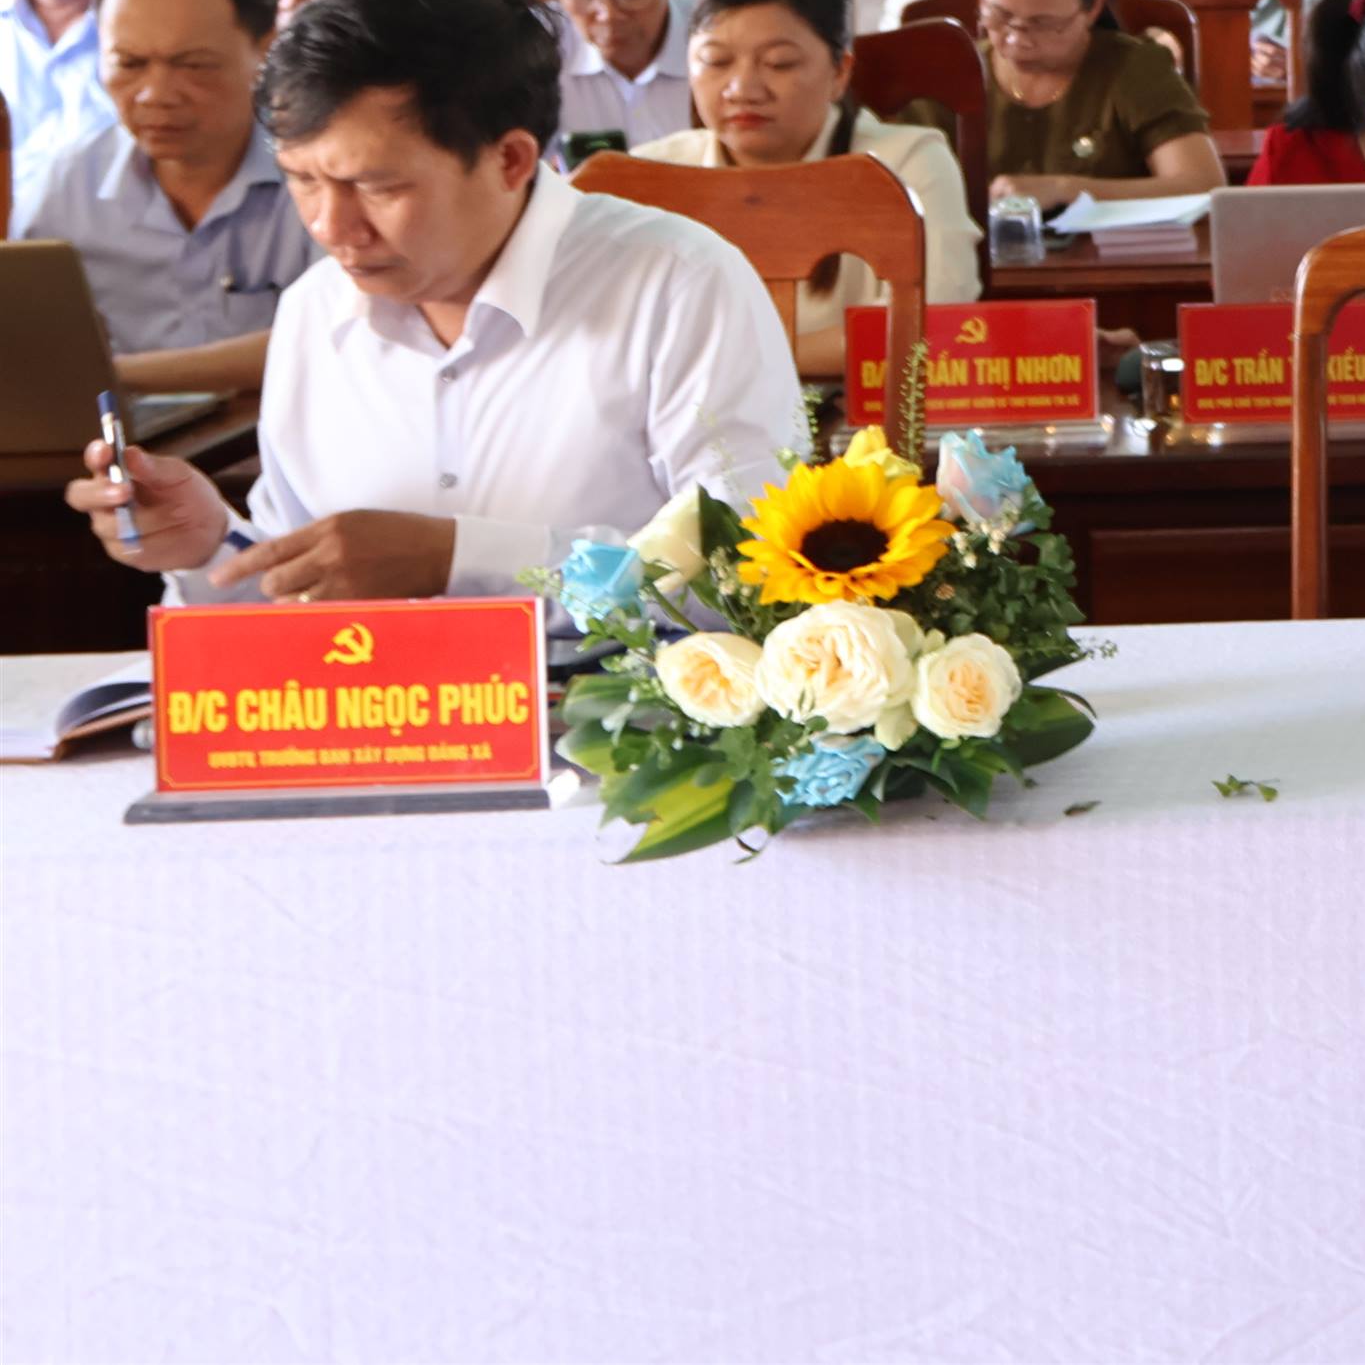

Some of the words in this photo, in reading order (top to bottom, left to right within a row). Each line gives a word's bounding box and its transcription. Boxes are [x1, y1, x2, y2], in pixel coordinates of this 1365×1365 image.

[974, 357, 1010, 391] THỊ
[1016, 354, 1081, 384] NHƠN
[1195, 357, 1228, 386] Đ/C
[1232, 348, 1284, 385] TRẦN
[168, 690, 228, 734] Đ/C
[236, 680, 328, 732] CHÂU
[336, 684, 430, 736] NGỌC
[438, 674, 529, 726] PHÚC
